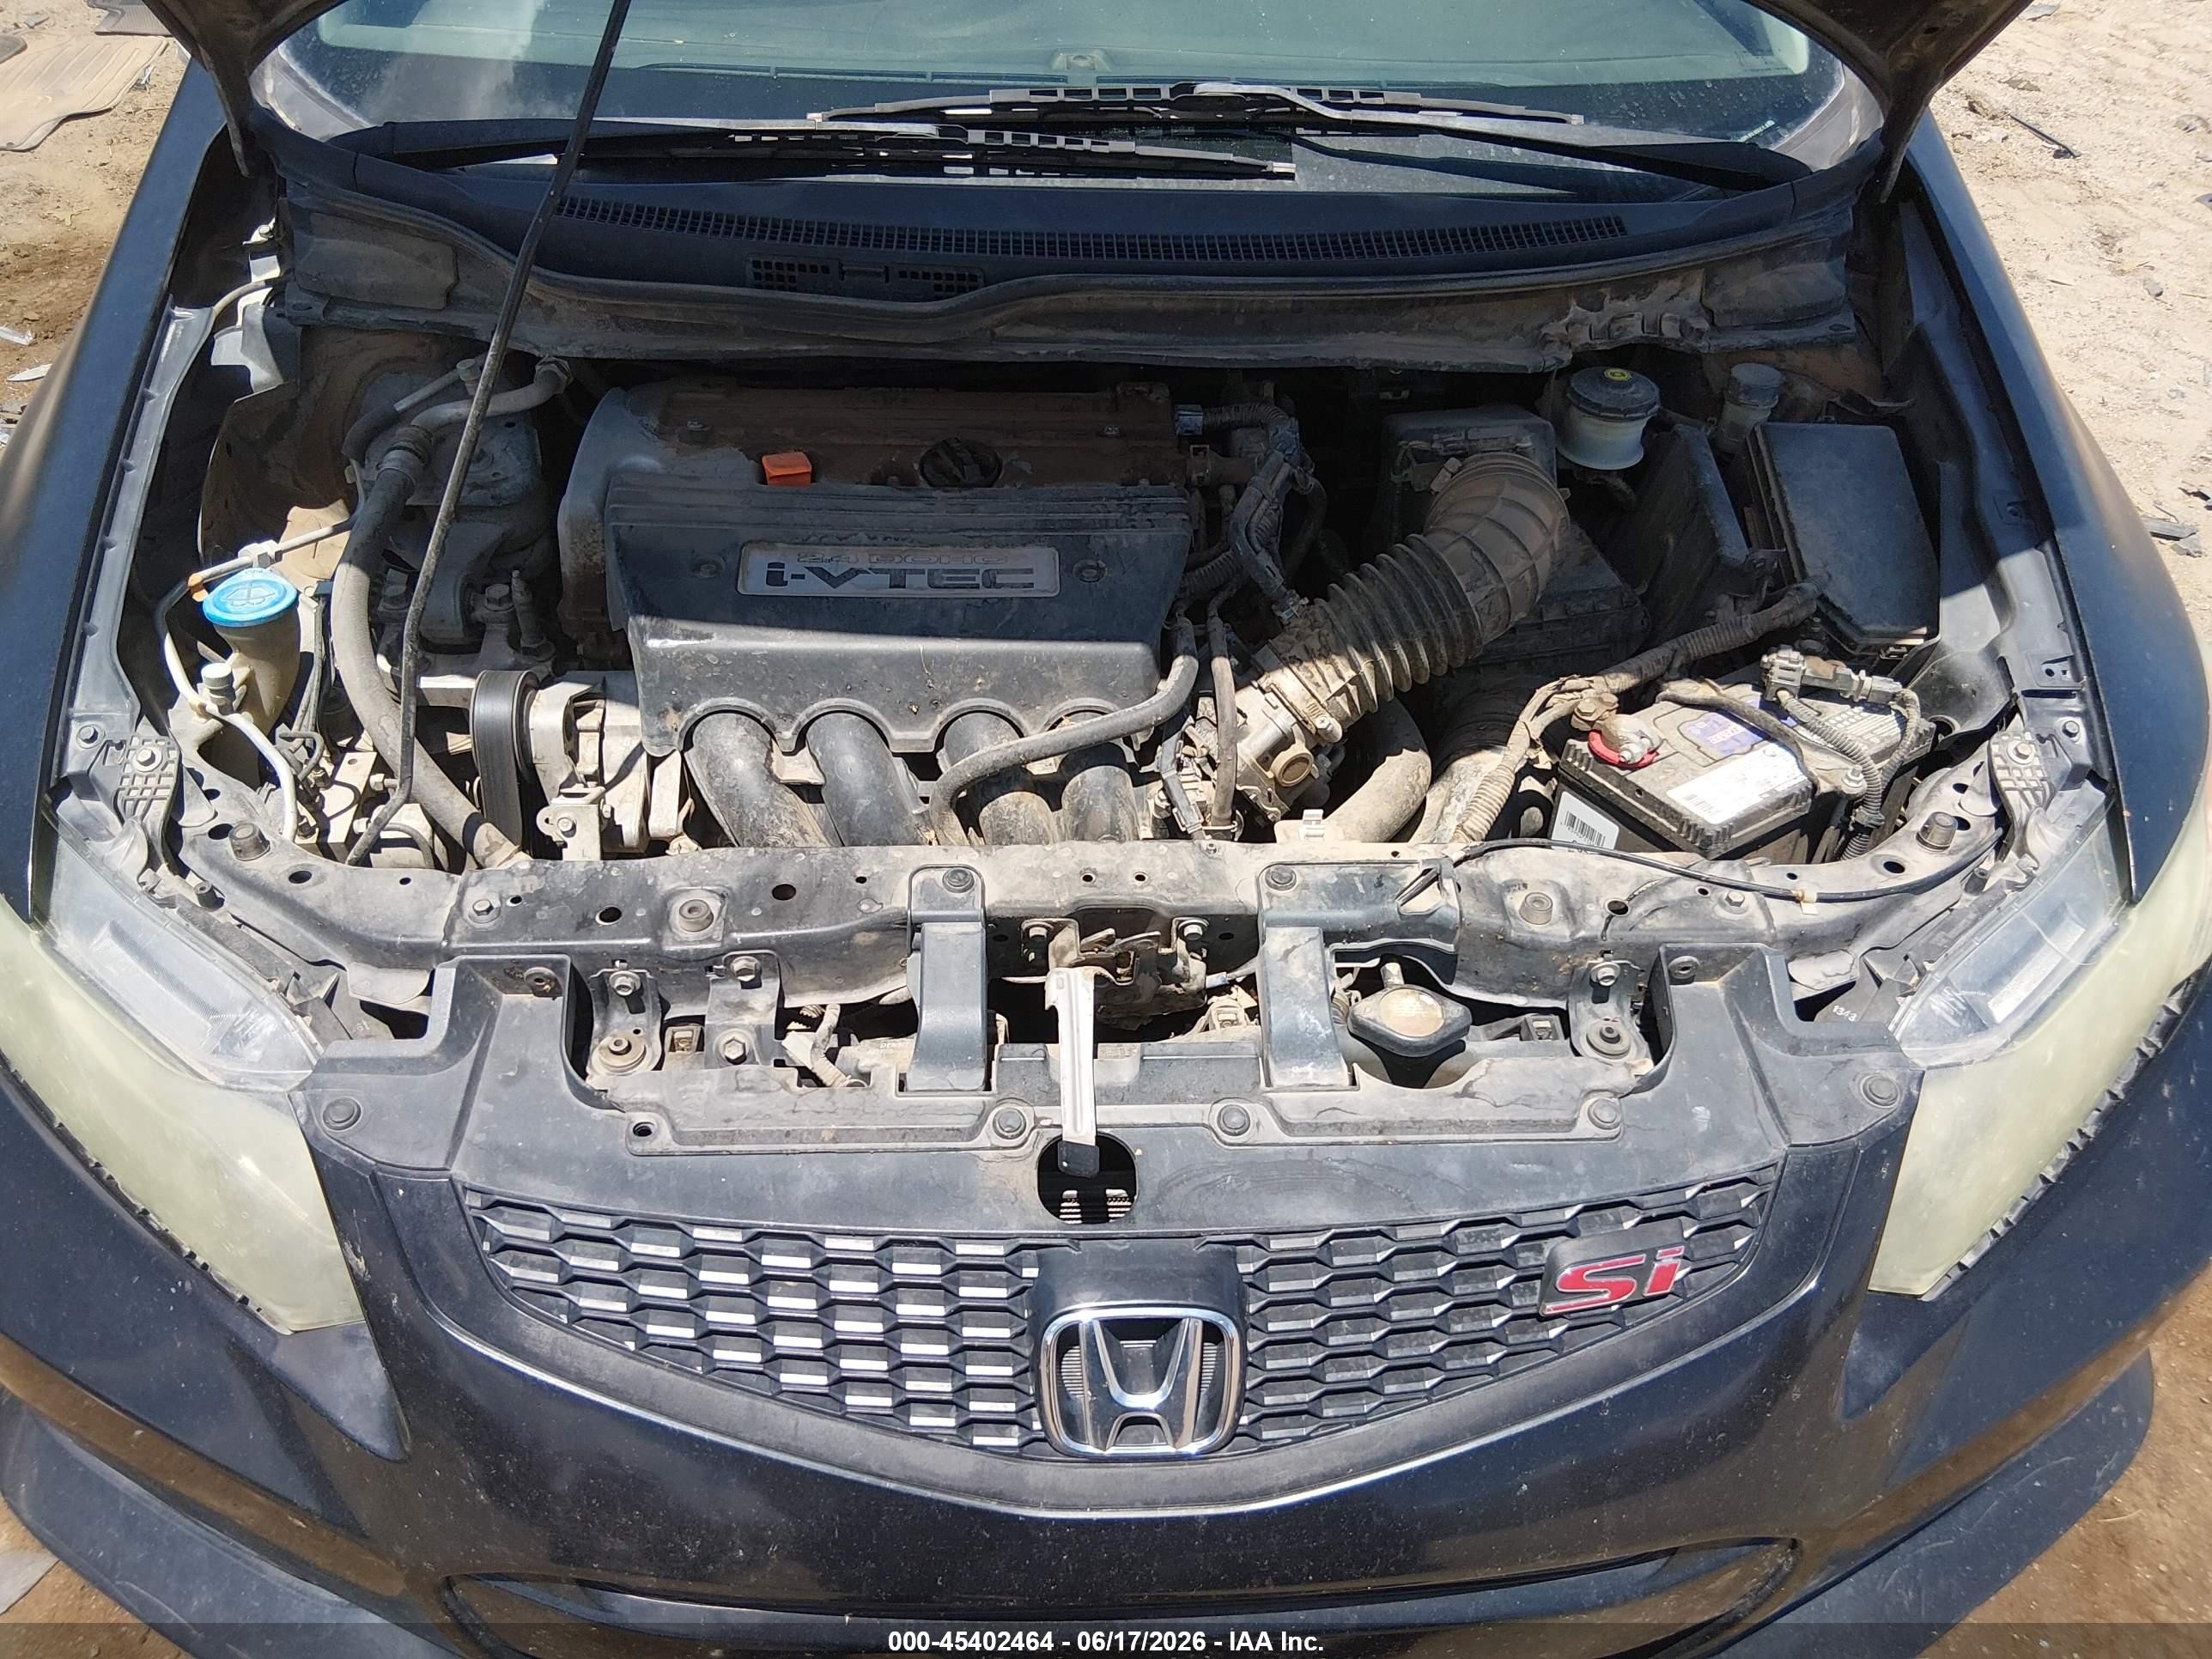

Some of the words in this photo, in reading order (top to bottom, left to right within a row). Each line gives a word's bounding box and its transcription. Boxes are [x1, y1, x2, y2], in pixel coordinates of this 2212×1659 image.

[796, 551, 859, 564] 2.4
[765, 562, 1035, 590] i-VTEC
[1545, 1245, 1686, 1316] Si
